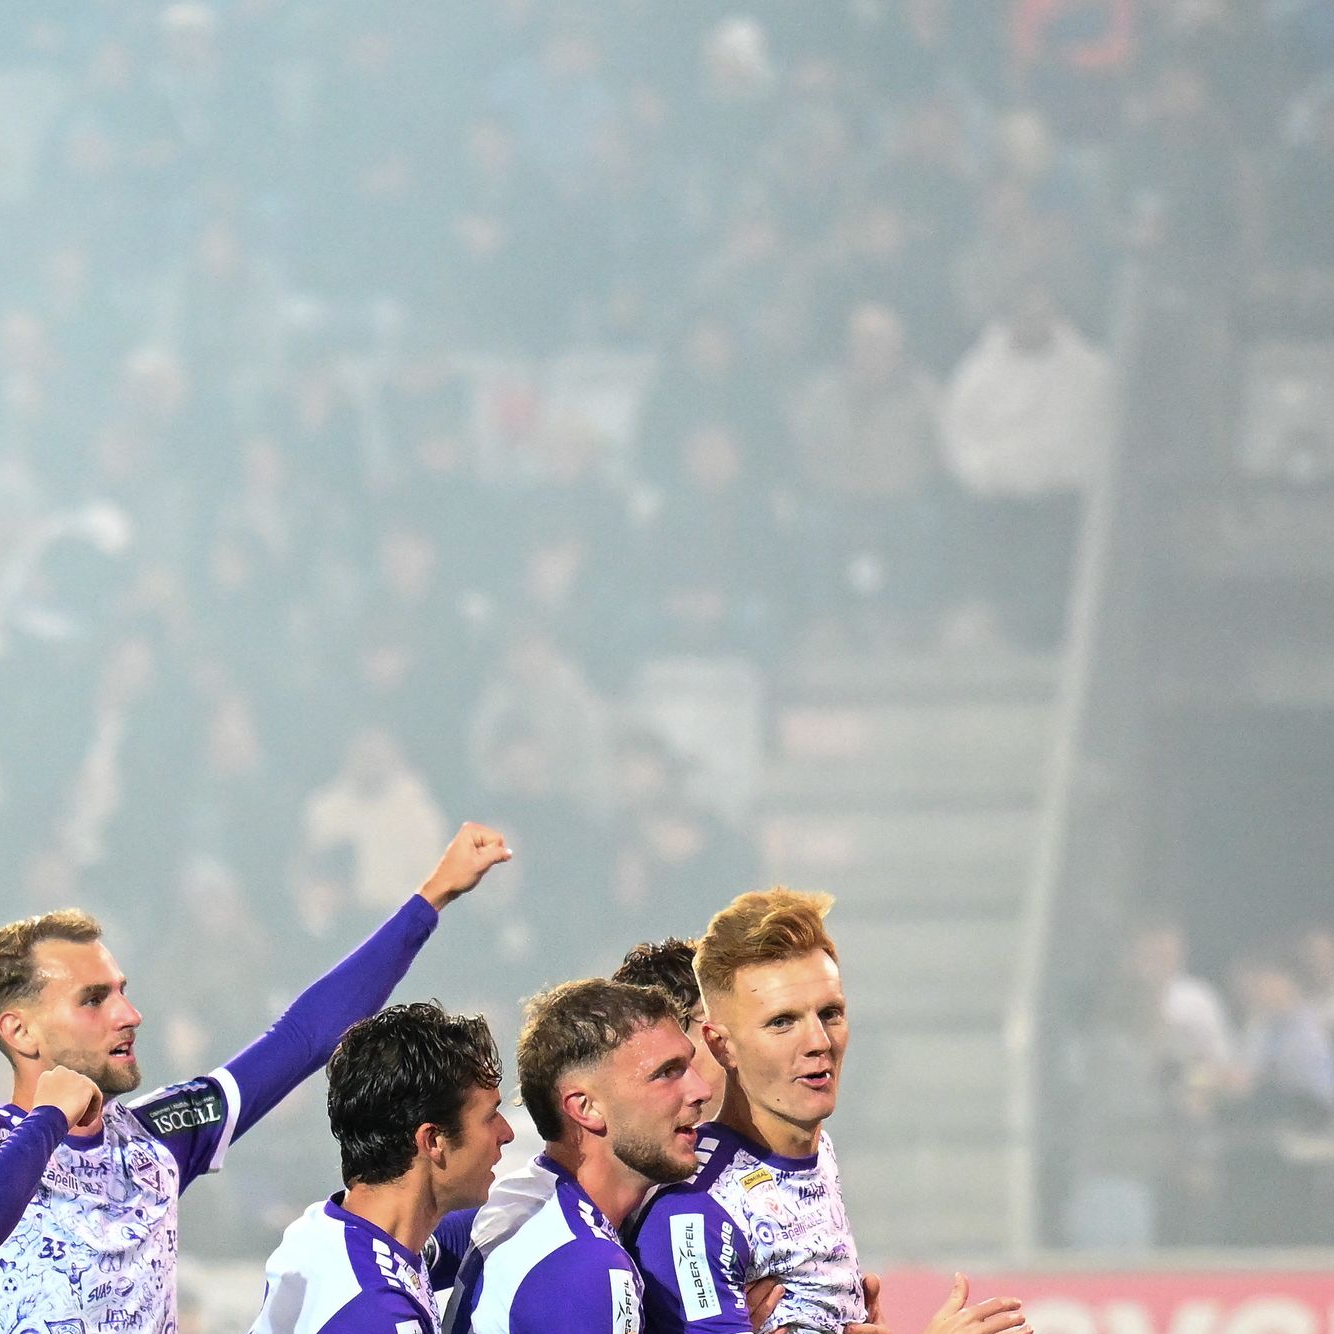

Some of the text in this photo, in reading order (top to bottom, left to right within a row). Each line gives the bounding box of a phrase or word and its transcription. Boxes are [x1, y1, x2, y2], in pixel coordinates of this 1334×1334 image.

[38, 1236, 67, 1262] 33
[685, 1222, 695, 1259] PFEIL
[689, 1260, 709, 1309] SILBER
